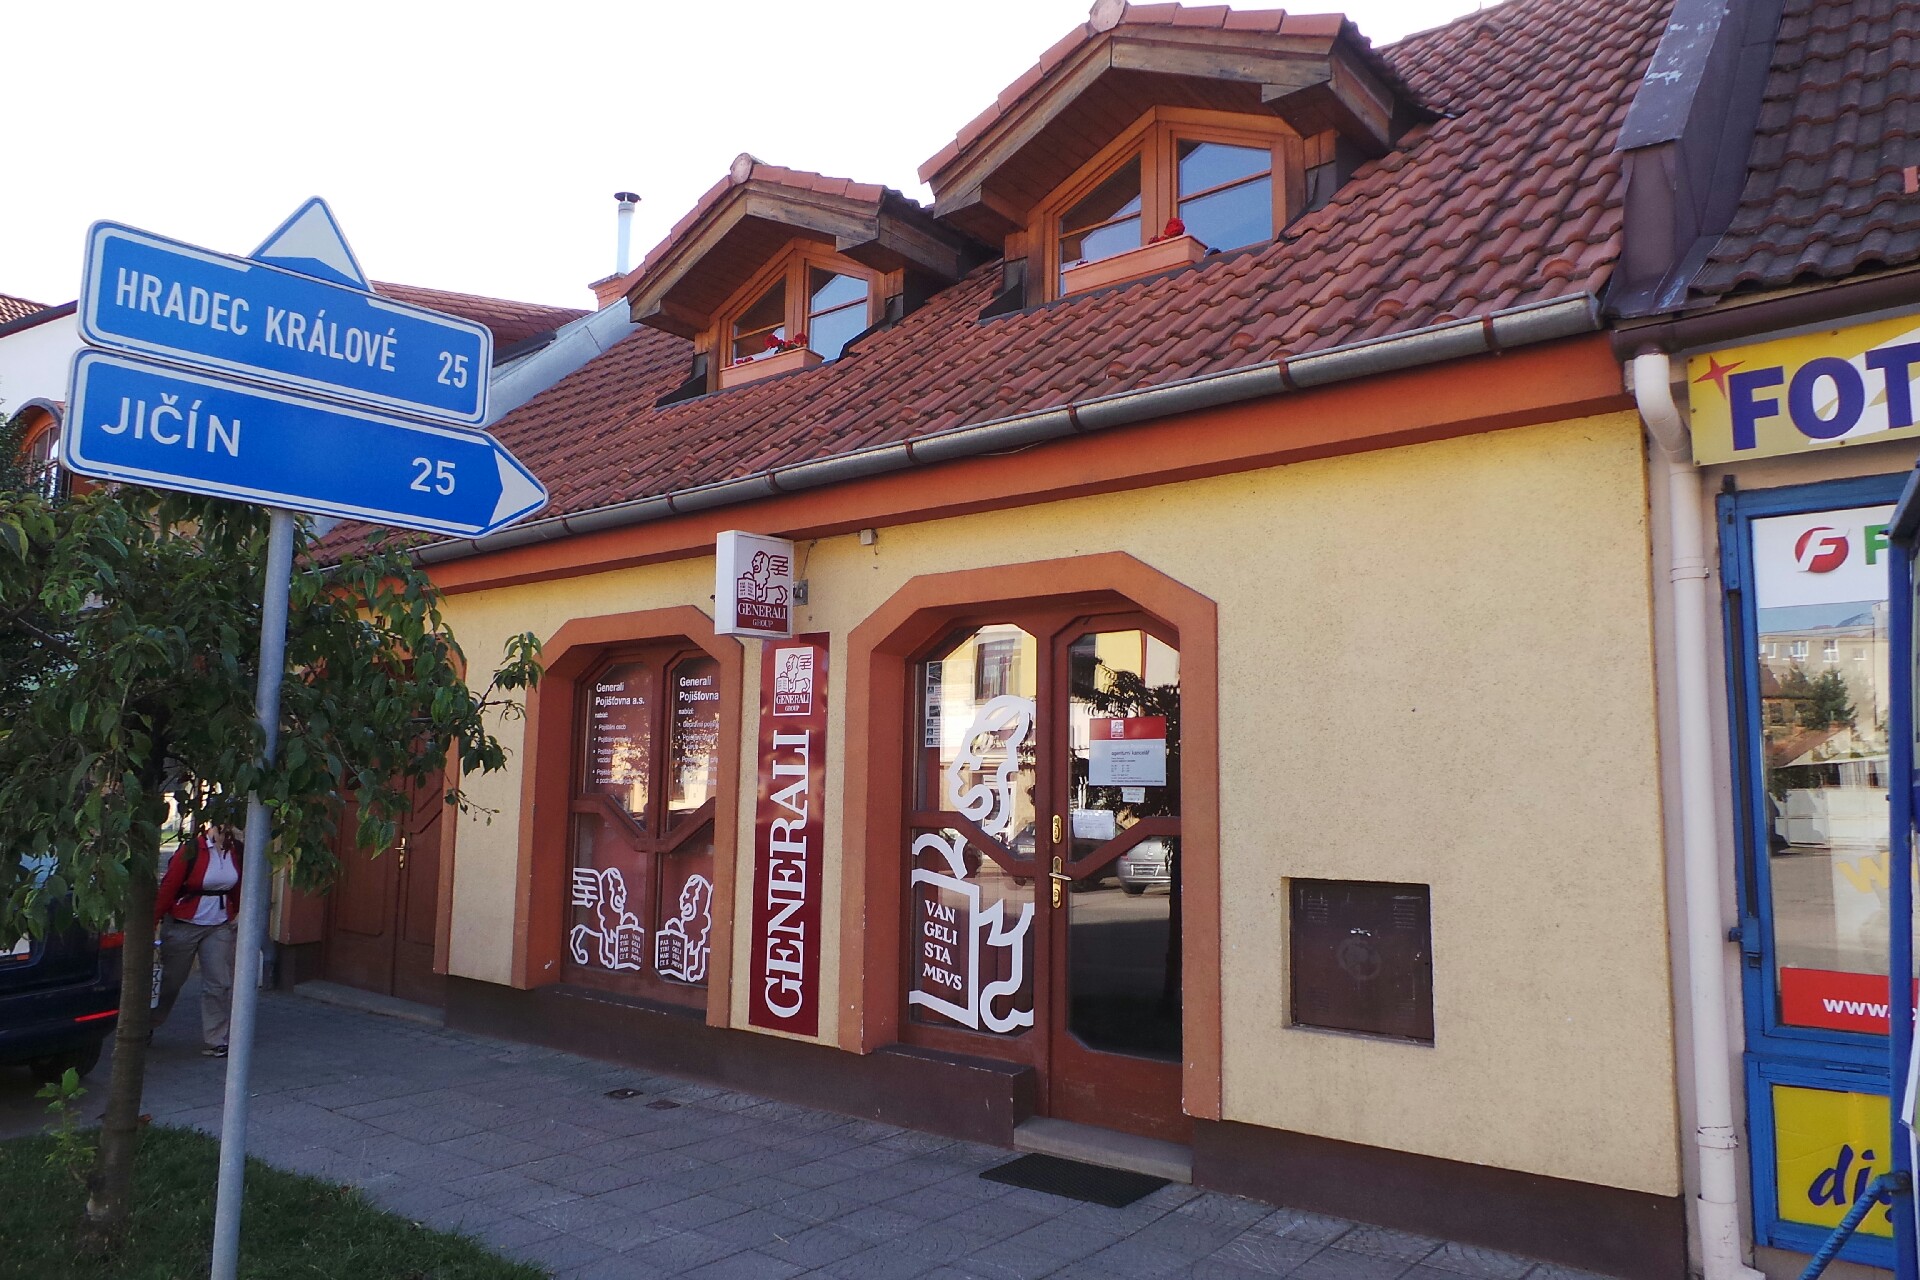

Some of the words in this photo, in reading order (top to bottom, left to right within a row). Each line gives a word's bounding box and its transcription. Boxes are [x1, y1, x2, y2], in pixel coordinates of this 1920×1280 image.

[116, 267, 250, 336] HRADEC
[265, 305, 398, 373] KRÁLOVÉ
[437, 351, 469, 389] 25
[1728, 342, 1920, 451] FOT
[101, 392, 241, 458] JIČÍN
[410, 457, 456, 496] 25
[738, 602, 787, 620] GENERALI
[752, 618, 774, 628] GROUP
[596, 681, 625, 693] Generali
[680, 675, 712, 687] Generali
[632, 696, 645, 706] a.s.
[776, 694, 810, 705] GENERALI
[764, 729, 810, 1018] GENERALI
[924, 899, 956, 925] VAN
[923, 920, 958, 946] GELI
[924, 941, 953, 966] STA
[922, 962, 963, 991] MEVS
